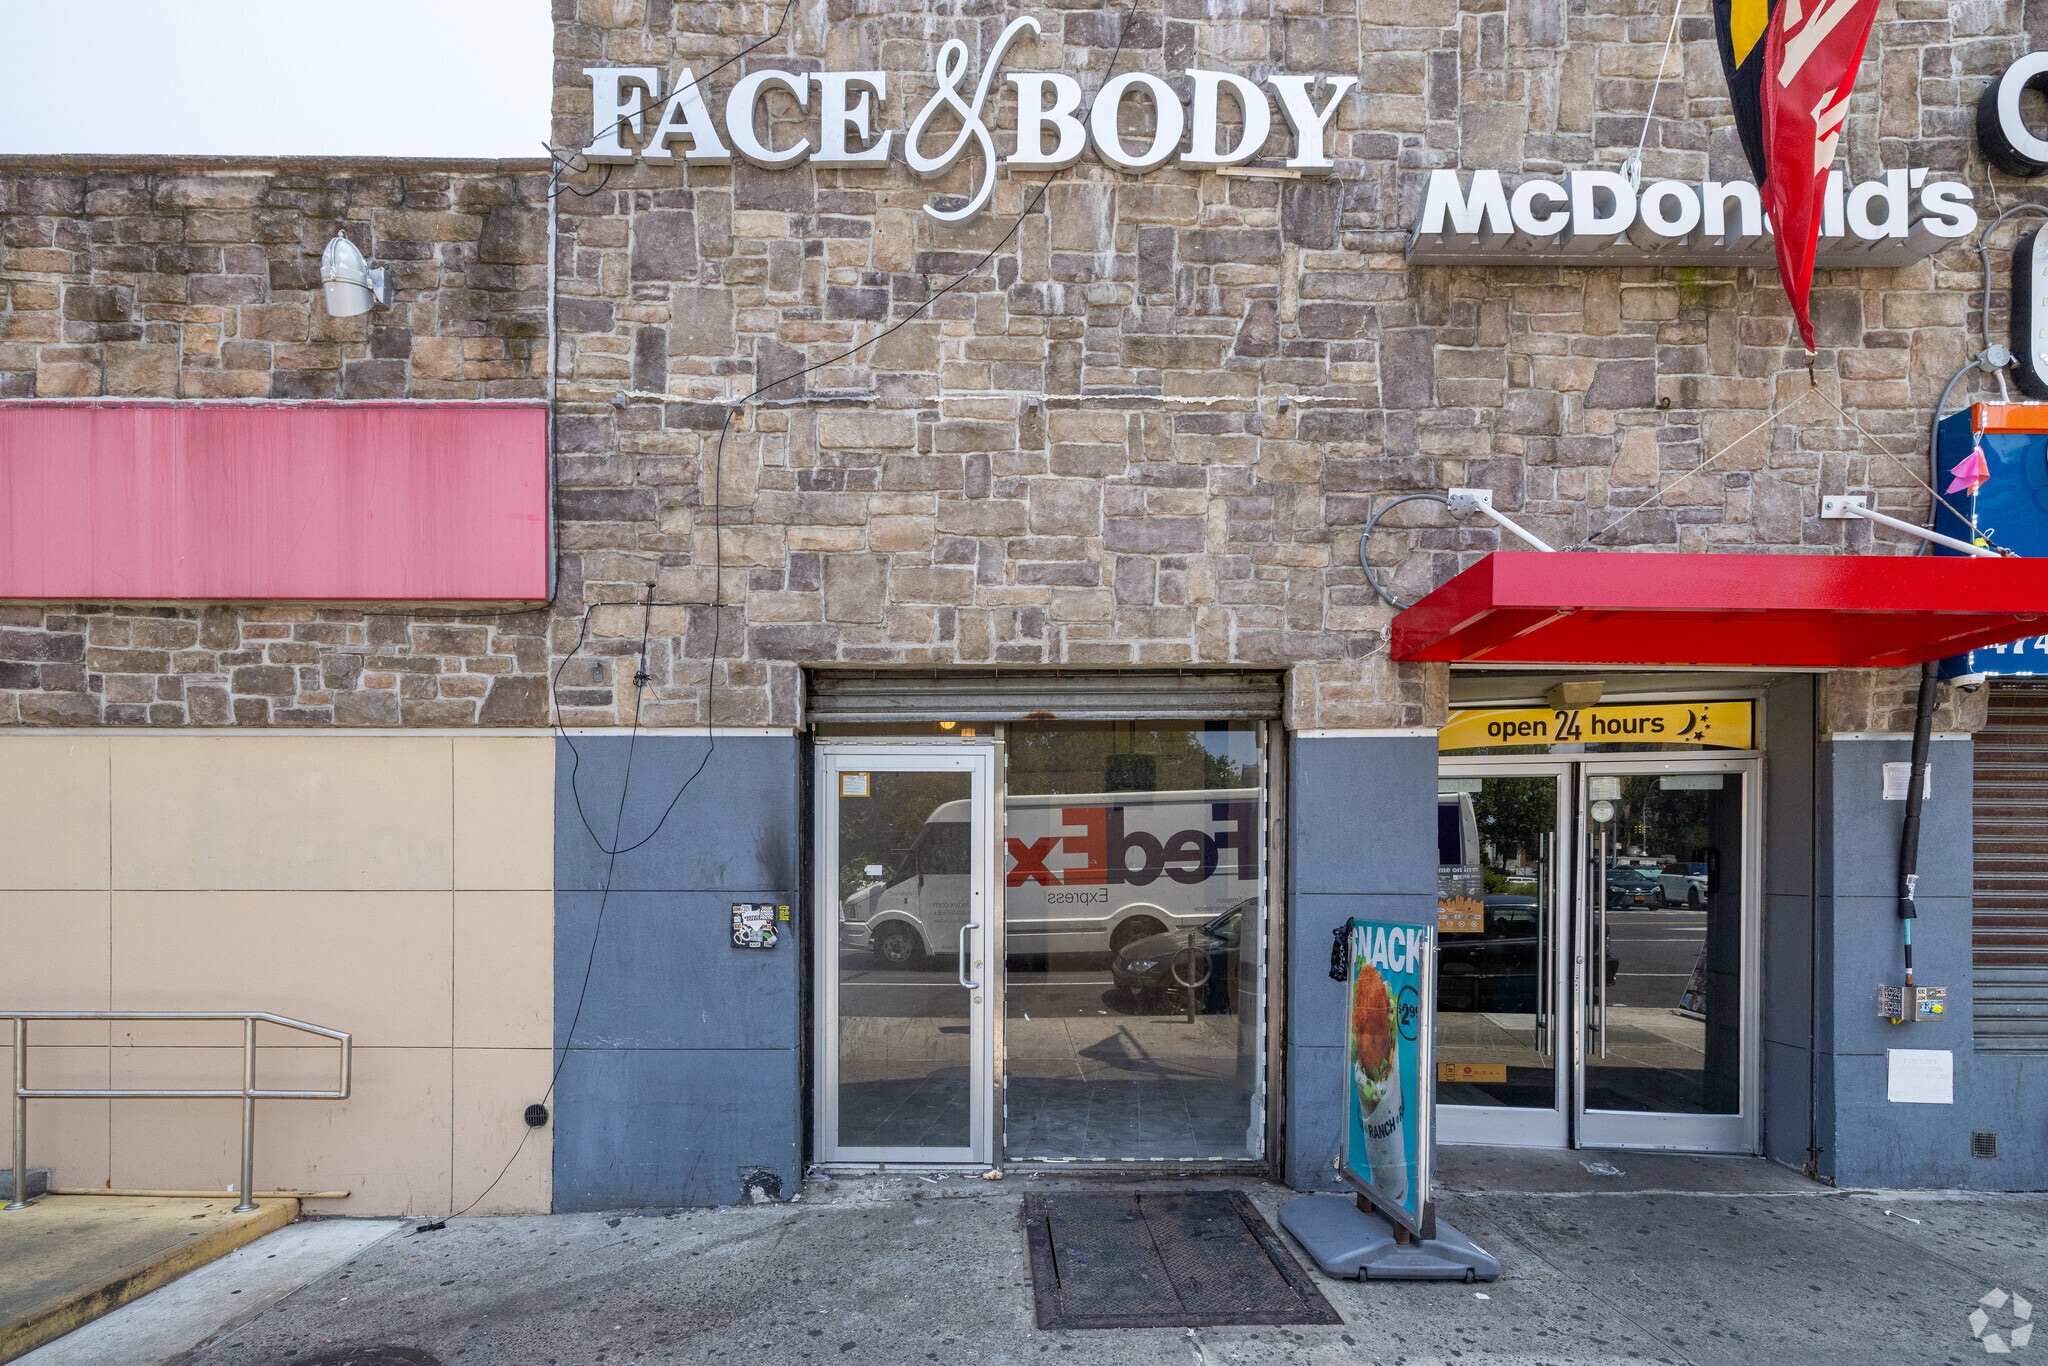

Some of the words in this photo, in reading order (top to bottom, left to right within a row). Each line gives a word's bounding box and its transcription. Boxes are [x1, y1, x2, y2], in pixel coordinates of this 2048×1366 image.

[582, 67, 893, 169] FACE
[905, 16, 1041, 229] &
[1006, 68, 1358, 176] BODY
[1420, 166, 1978, 240] McDonld's
[1487, 719, 1547, 742] open
[1554, 710, 1582, 741] 24
[1591, 713, 1665, 735] hours
[1368, 1116, 1396, 1139] RANCH
